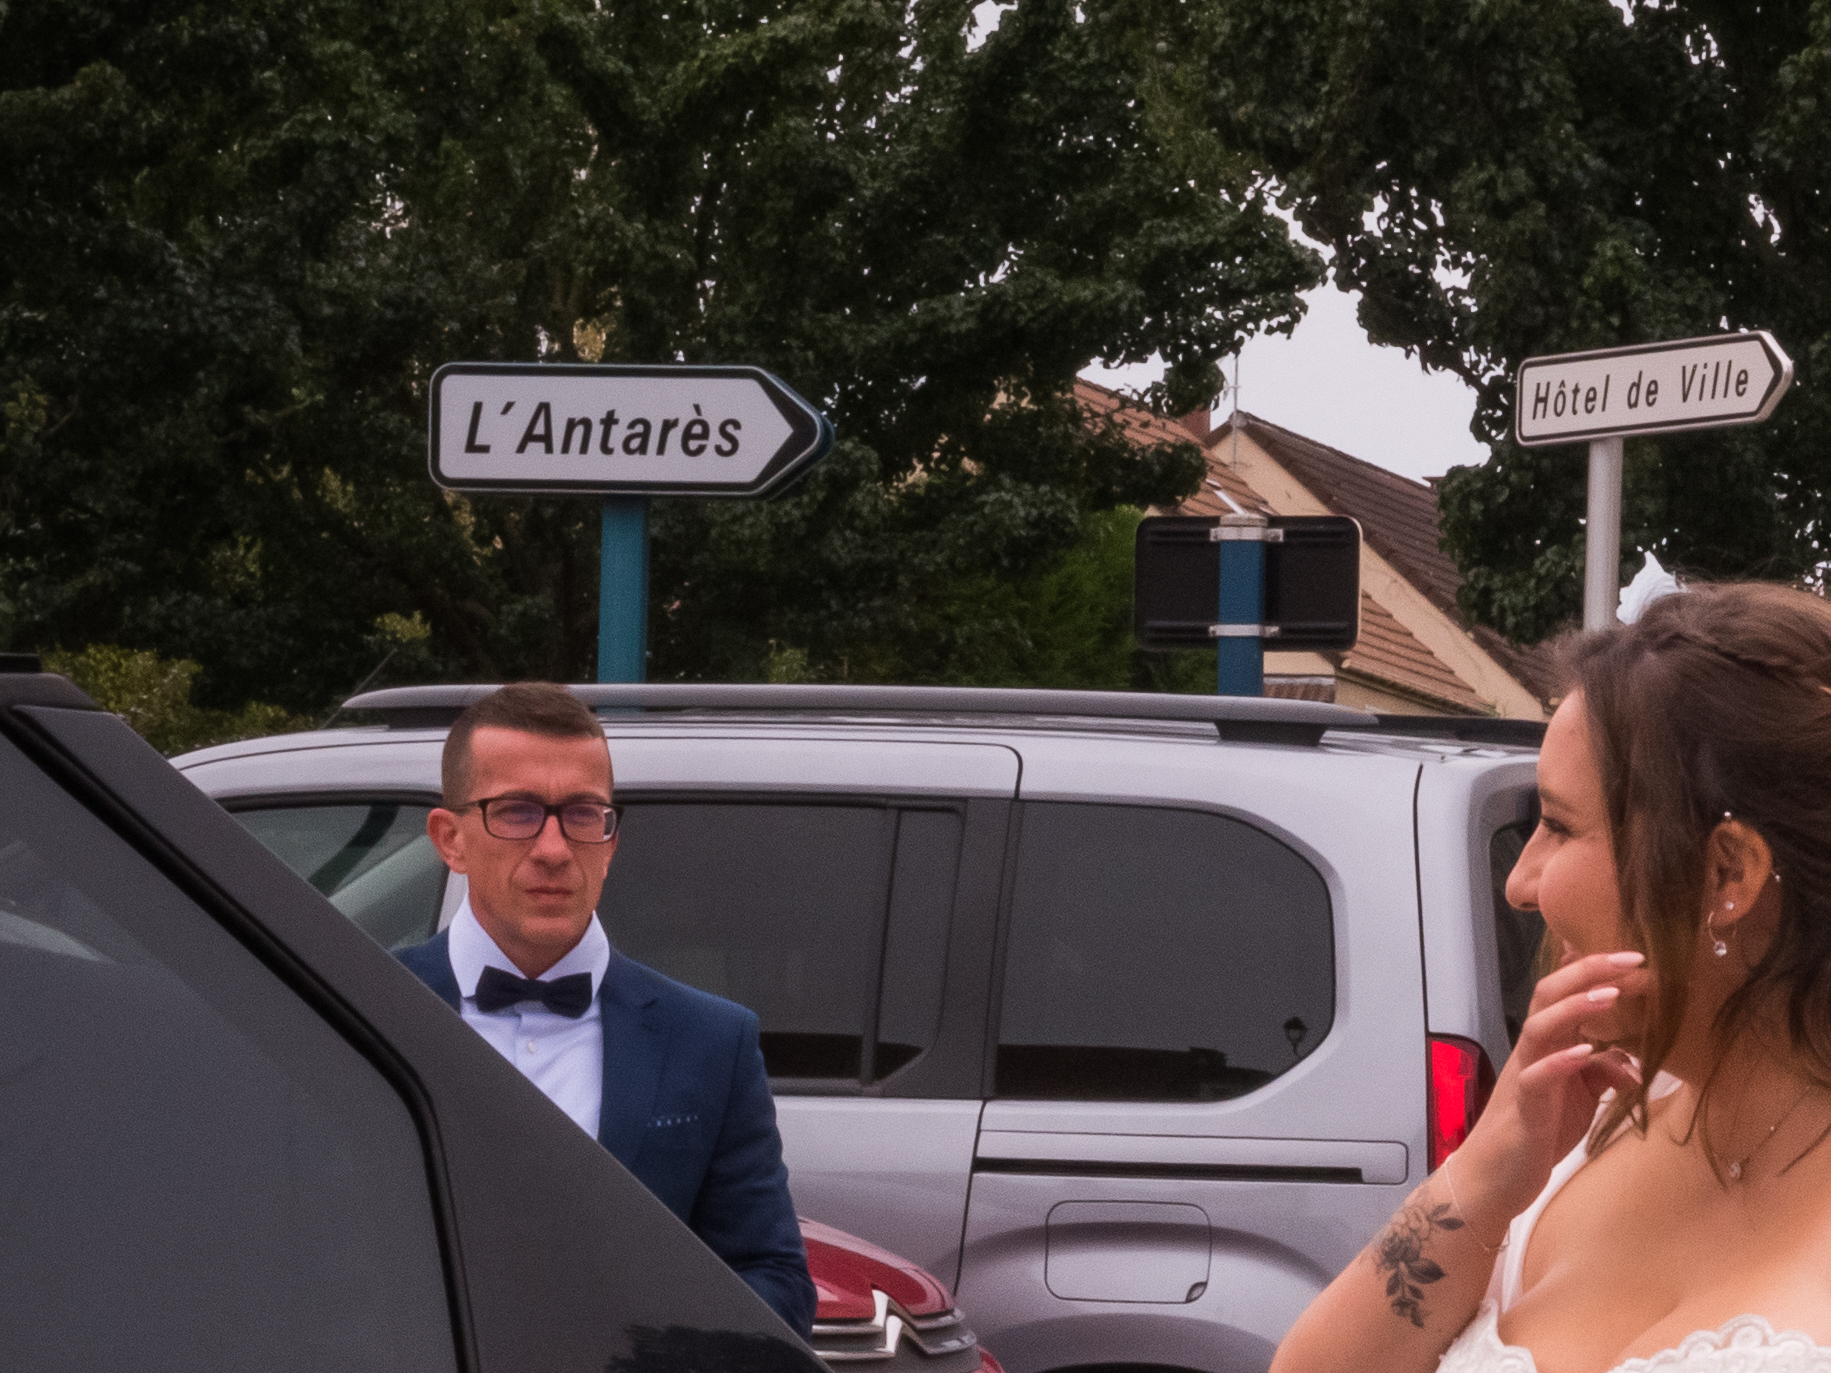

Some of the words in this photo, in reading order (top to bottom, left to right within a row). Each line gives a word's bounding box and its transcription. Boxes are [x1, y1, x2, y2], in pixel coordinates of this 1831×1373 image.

[1532, 374, 1610, 420] Hôtel
[1627, 370, 1659, 410] de
[1681, 359, 1749, 403] Ville
[464, 401, 742, 457] L'Antarès
